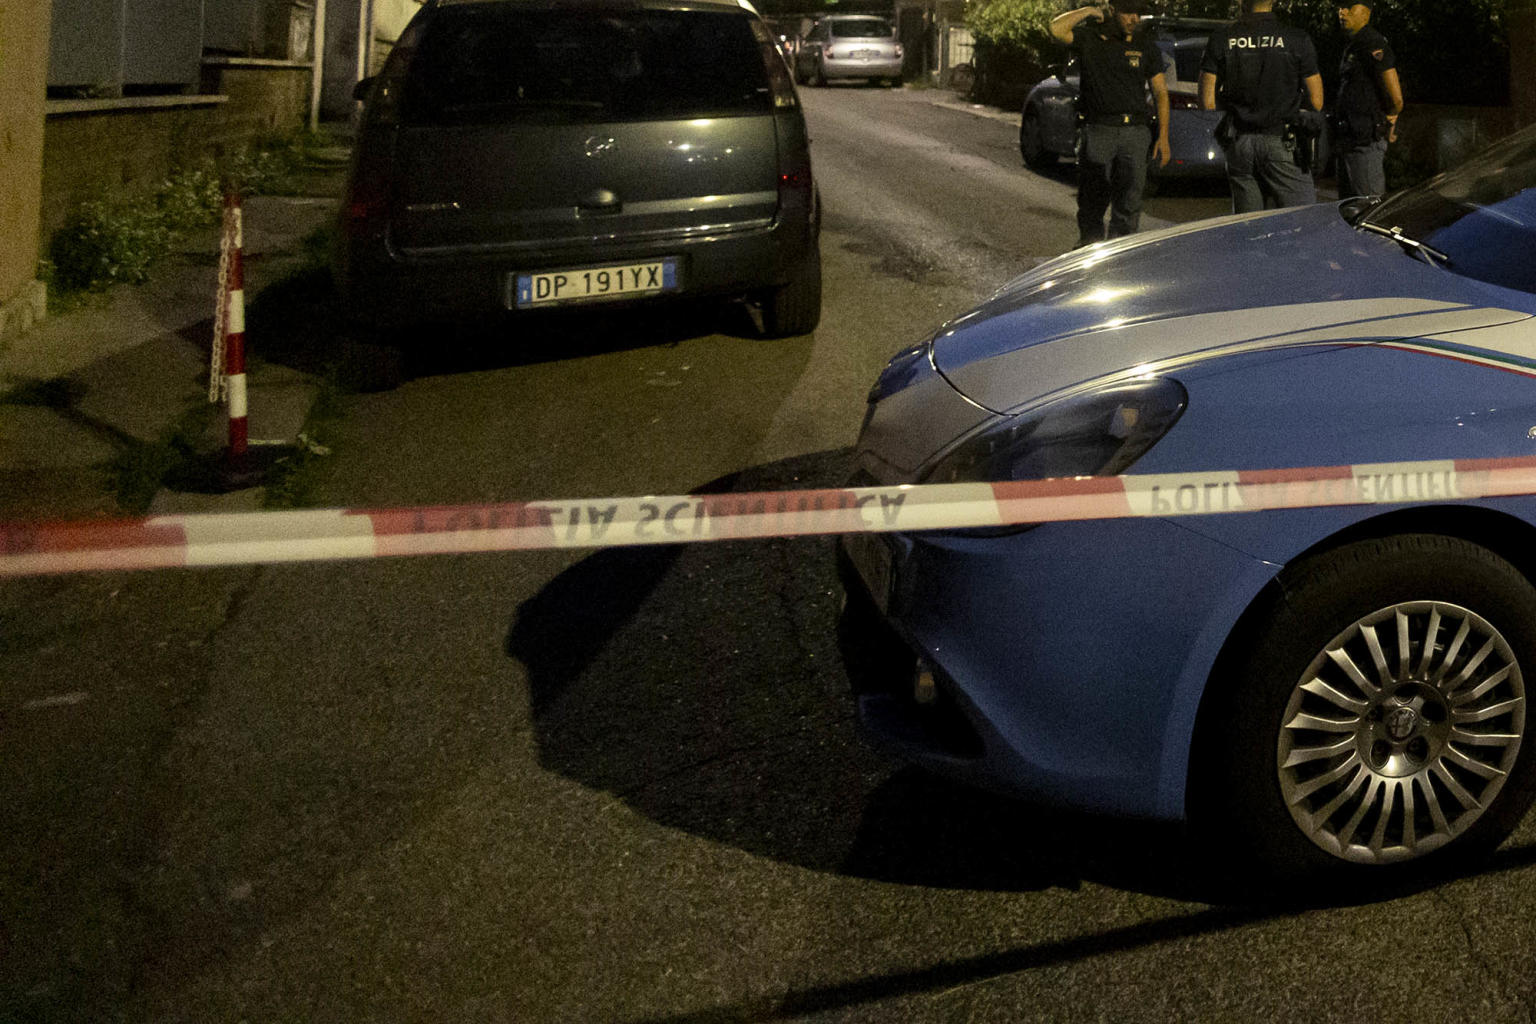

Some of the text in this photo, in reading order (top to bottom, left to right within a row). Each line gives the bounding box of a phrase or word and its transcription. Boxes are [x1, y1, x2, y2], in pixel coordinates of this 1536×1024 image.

[1228, 35, 1285, 50] POLIZIA
[536, 265, 660, 300] DP 191YX
